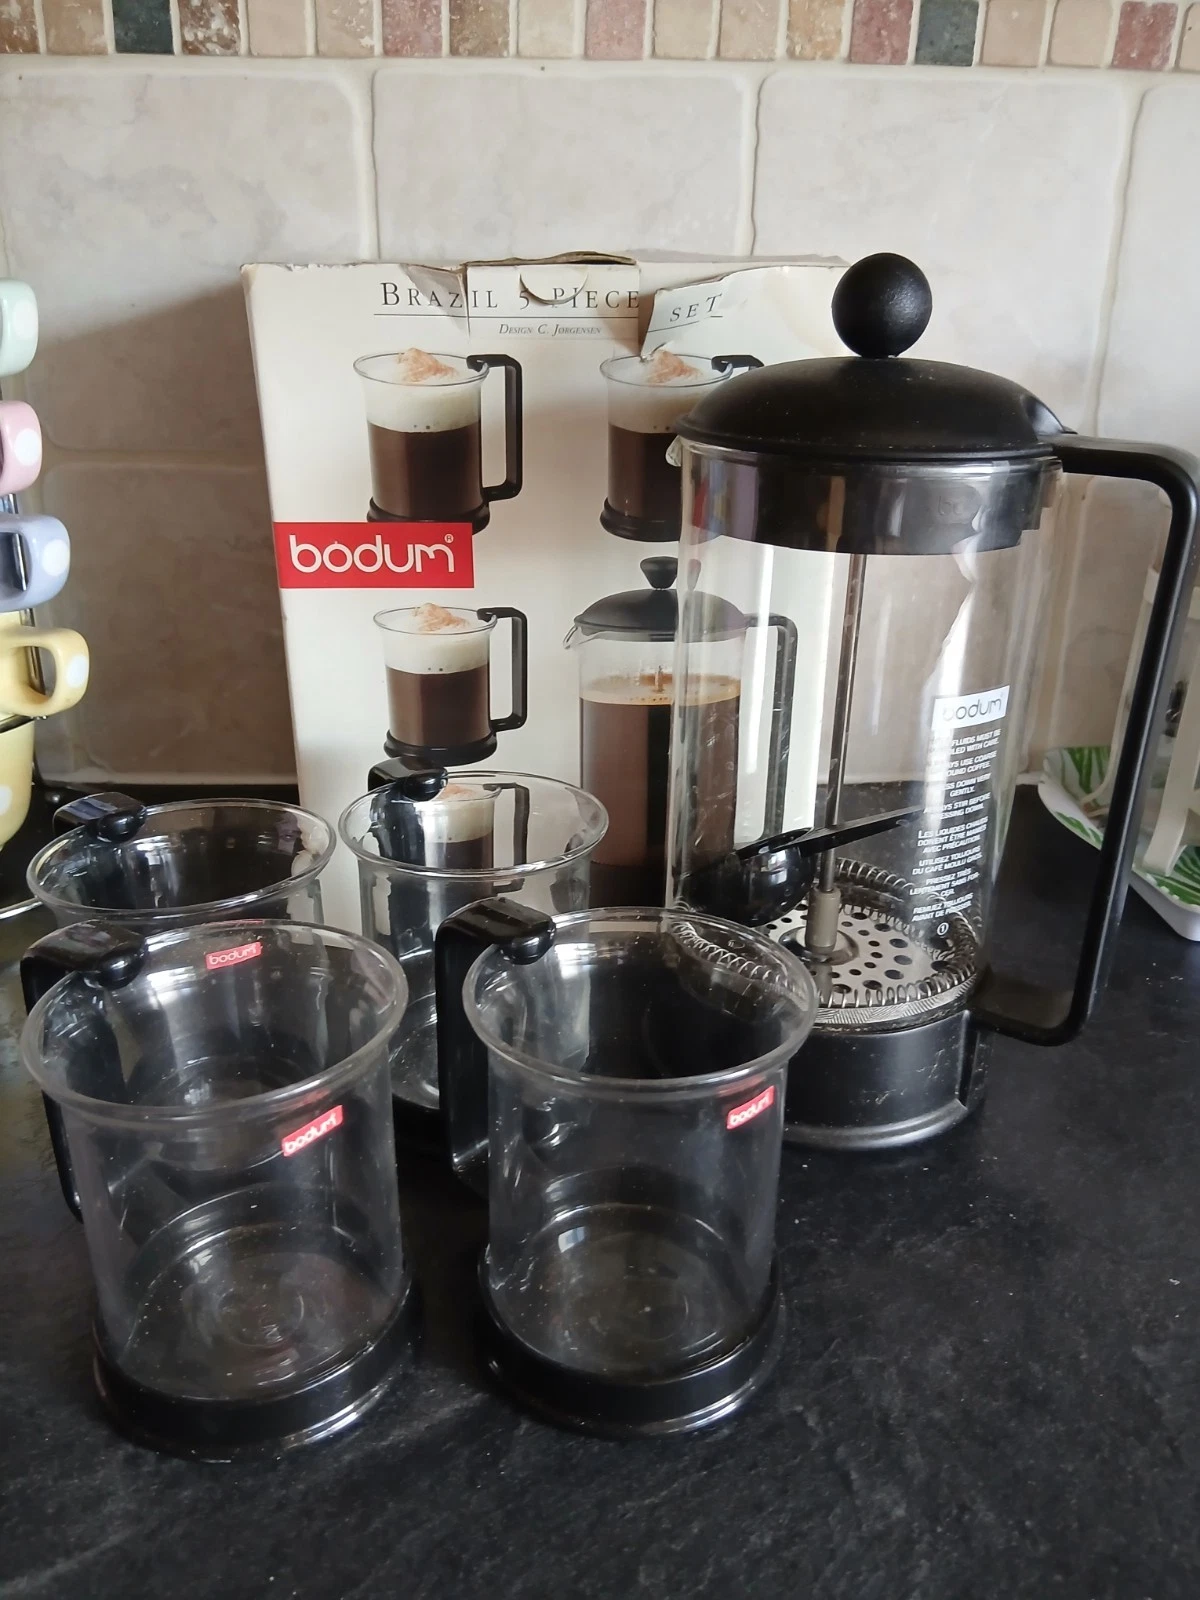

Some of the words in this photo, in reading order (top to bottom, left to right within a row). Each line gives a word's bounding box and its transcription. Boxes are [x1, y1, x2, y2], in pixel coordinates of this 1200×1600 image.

[380, 282, 498, 309] BRAZIL
[519, 289, 530, 310] 5
[552, 287, 640, 309] PIECE
[669, 293, 723, 322] SET
[499, 323, 532, 335] DESIGN
[537, 323, 549, 335] C.
[552, 323, 602, 337] JØRGENSEN
[960, 757, 974, 766] USE
[956, 777, 976, 788] DOWN
[953, 800, 968, 809] STIR
[919, 855, 950, 867] UTILISEZ
[950, 845, 981, 861] TOUJOURS
[944, 859, 967, 870] MOULU
[926, 873, 957, 885] PRESSEZ
